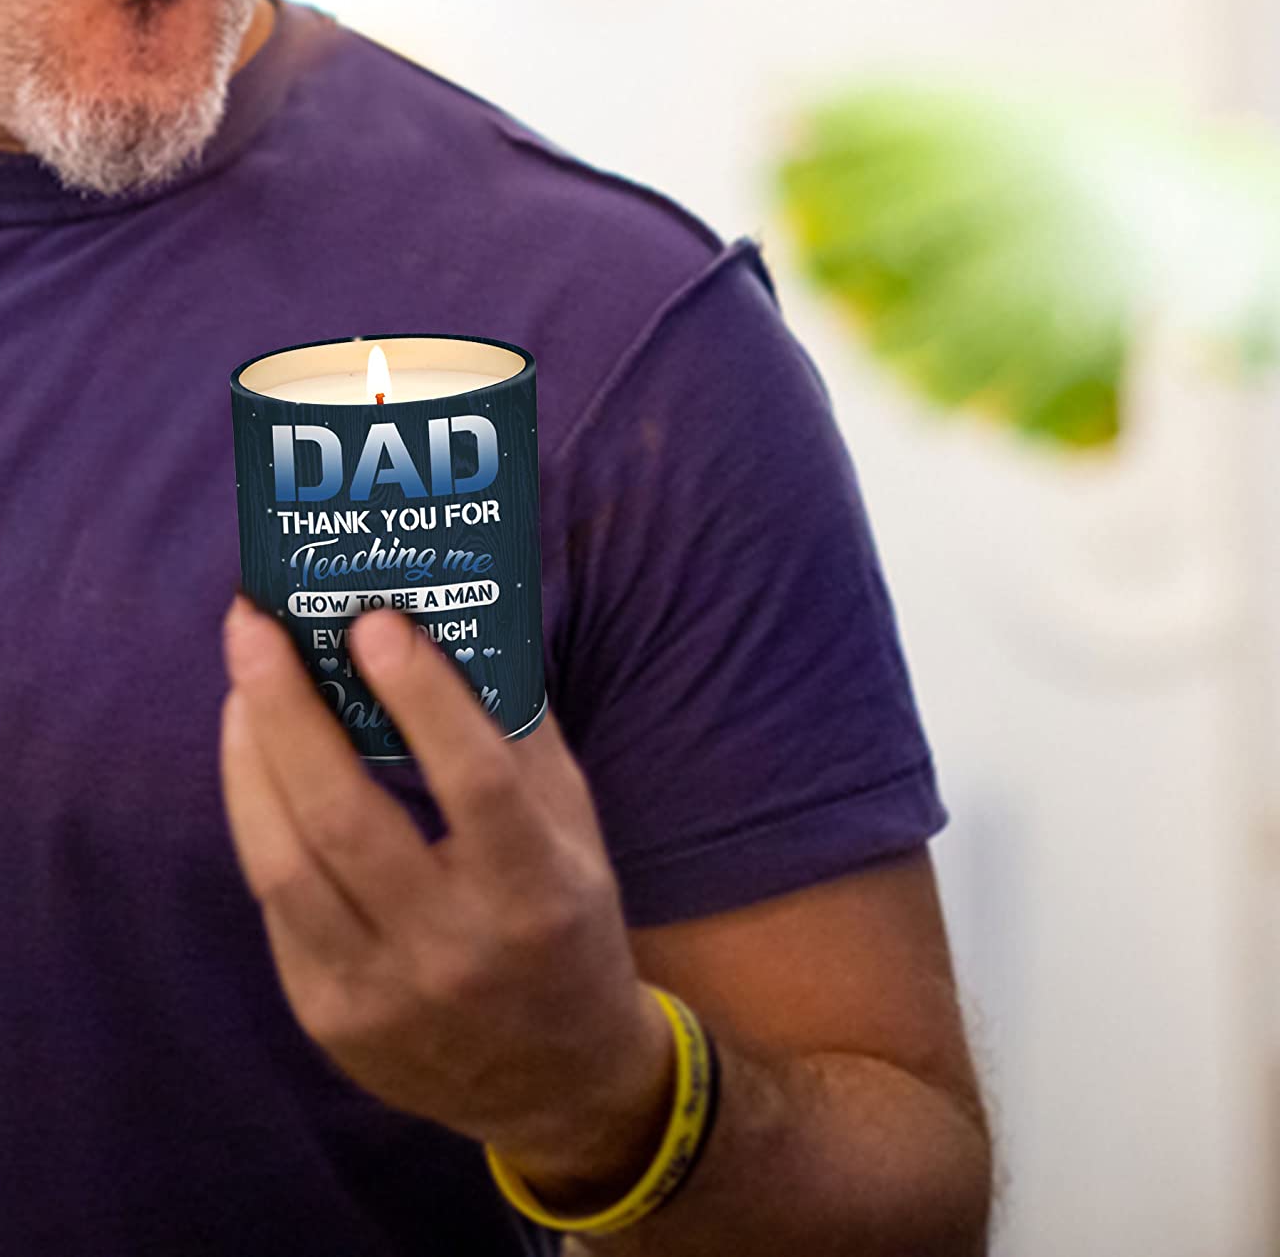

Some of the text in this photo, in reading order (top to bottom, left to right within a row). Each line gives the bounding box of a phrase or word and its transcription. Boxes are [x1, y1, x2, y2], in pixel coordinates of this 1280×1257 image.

[271, 414, 500, 503] DAD
[277, 499, 501, 535] THANK YOU FOR
[289, 537, 495, 588] Teaching me
[295, 583, 493, 613] HOW TO BE A MAN
